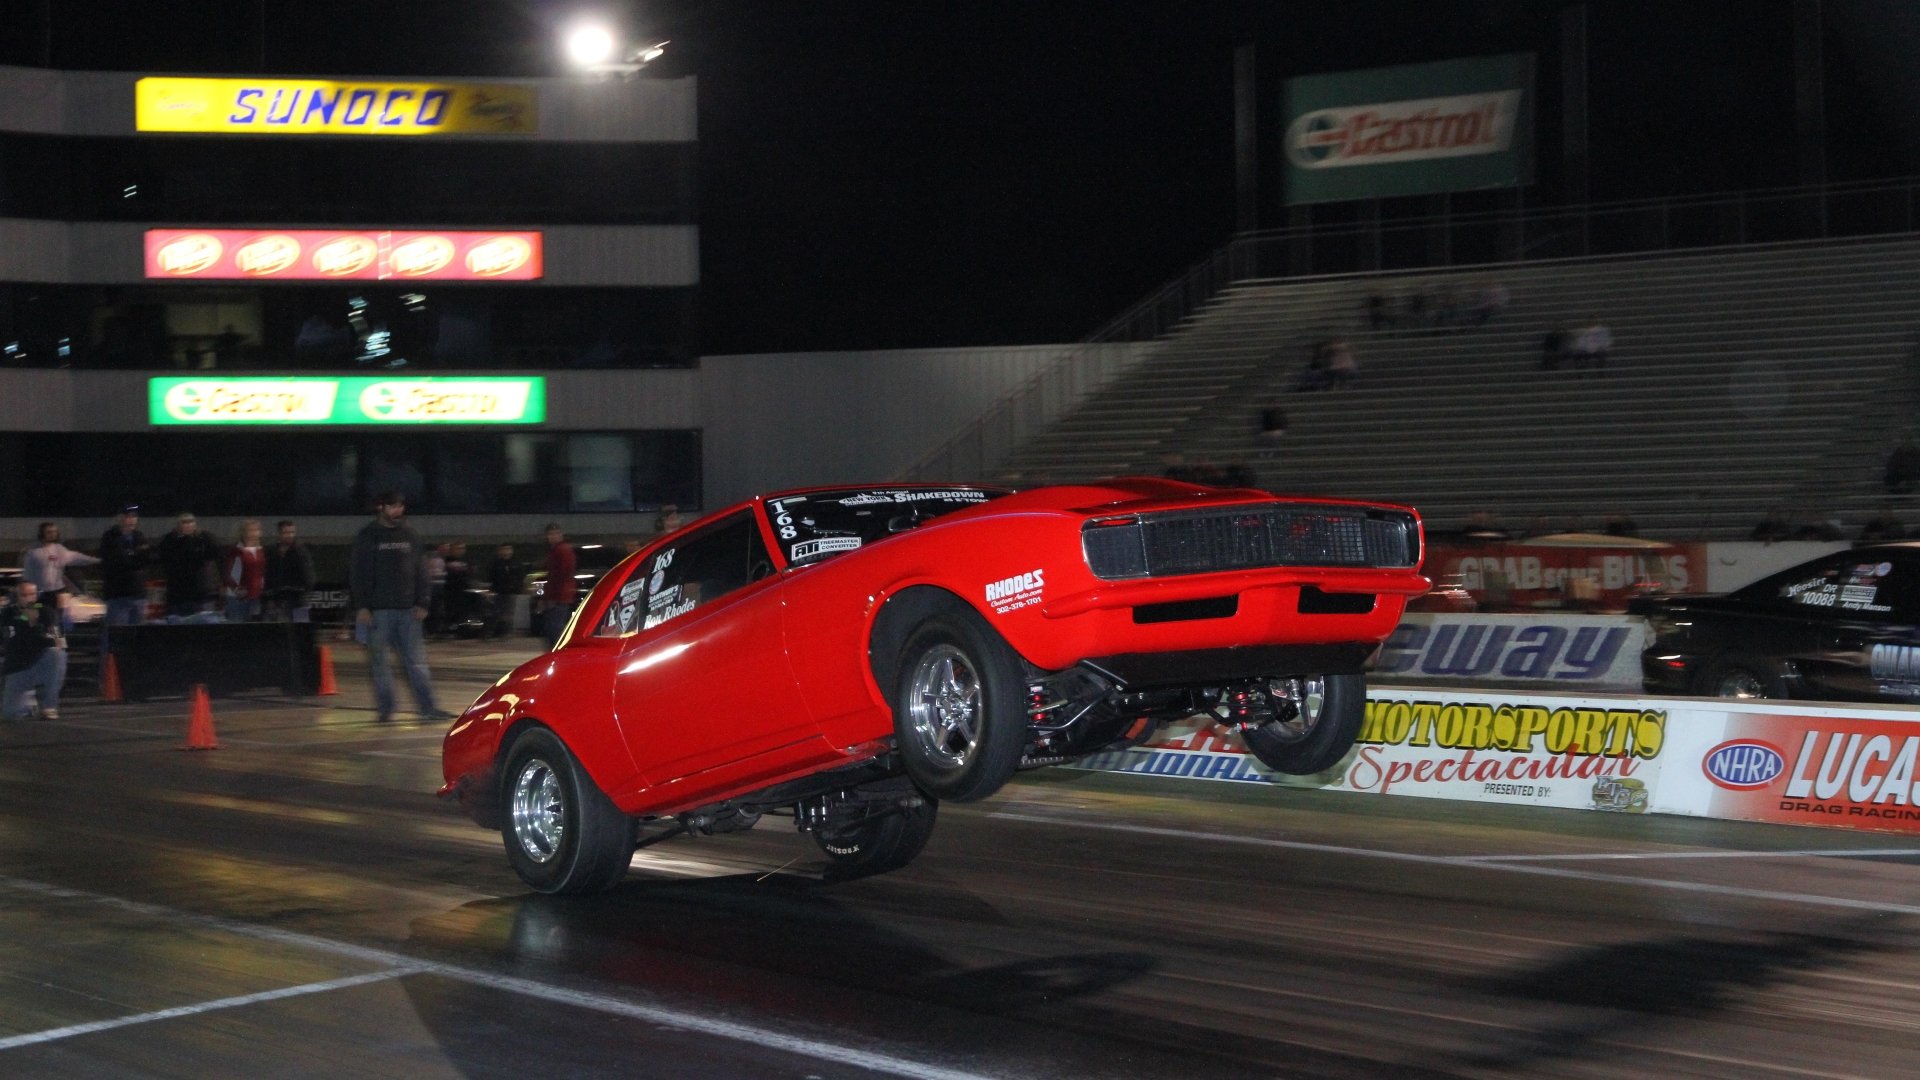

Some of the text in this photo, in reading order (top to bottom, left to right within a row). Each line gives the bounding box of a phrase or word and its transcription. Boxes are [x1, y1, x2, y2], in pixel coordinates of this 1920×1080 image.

[229, 87, 453, 126] SUNOCO
[1341, 101, 1499, 158] Castrol
[894, 490, 985, 502] SHAKEDOWN
[770, 501, 798, 540] 168
[651, 548, 676, 573] 168
[990, 589, 1043, 608] Custom Auto.com
[1802, 591, 1837, 607] 10088
[1823, 584, 1838, 593] DR
[643, 613, 662, 630] Ron
[663, 598, 696, 622] Rhodes
[996, 596, 1042, 614] 302-378-1701
[1842, 601, 1862, 611] Andy
[1356, 698, 1668, 760] MOTORSPORTS
[1349, 742, 1642, 795] Spectacular
[1713, 746, 1776, 783] NHRA
[1483, 783, 1534, 798] PRESENTED
[1779, 801, 1842, 815] DRAG
